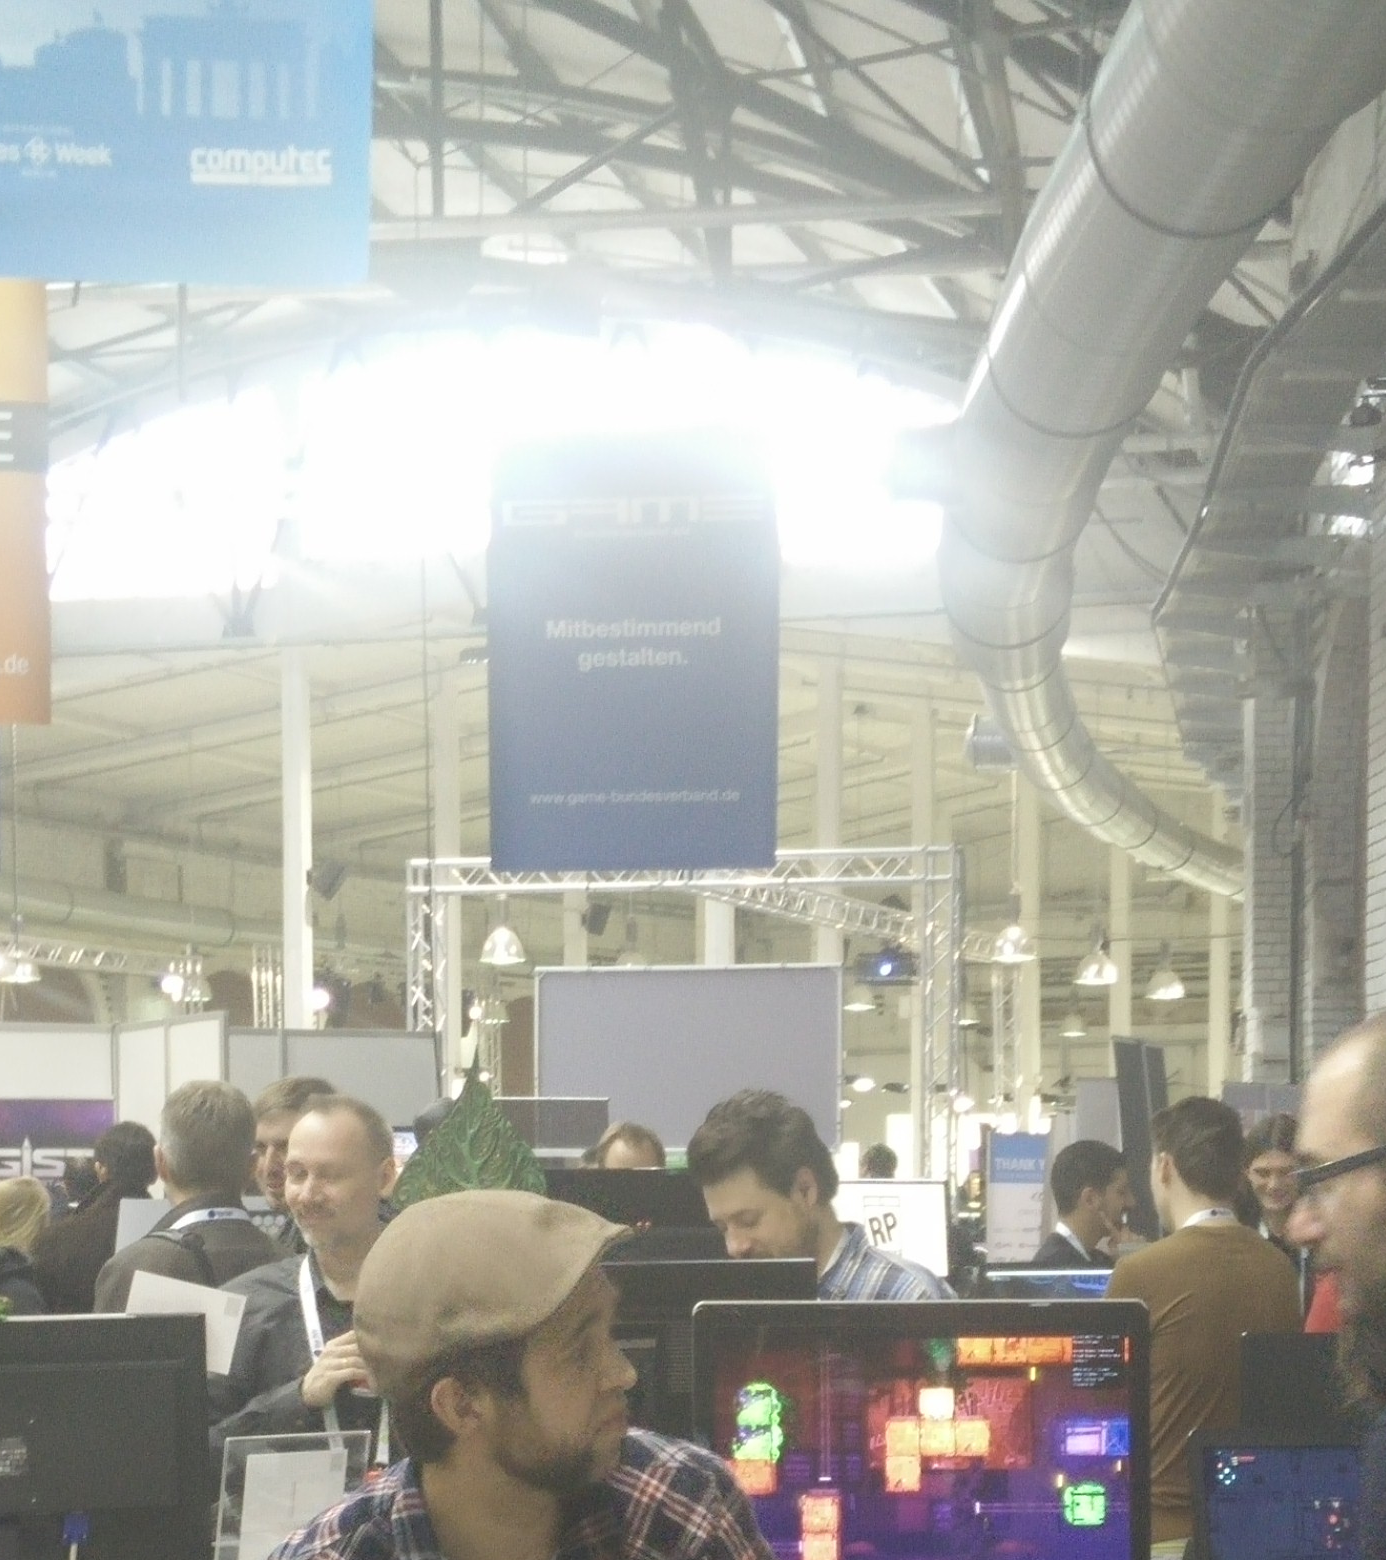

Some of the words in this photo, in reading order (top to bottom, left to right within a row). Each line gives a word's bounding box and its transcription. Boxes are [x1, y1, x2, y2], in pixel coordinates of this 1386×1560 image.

[55, 142, 112, 166] Week
[190, 145, 332, 180] computec
[545, 616, 722, 640] Mitbestimmend
[577, 646, 689, 673] gestalten.
[994, 1157, 1036, 1171] THANK
